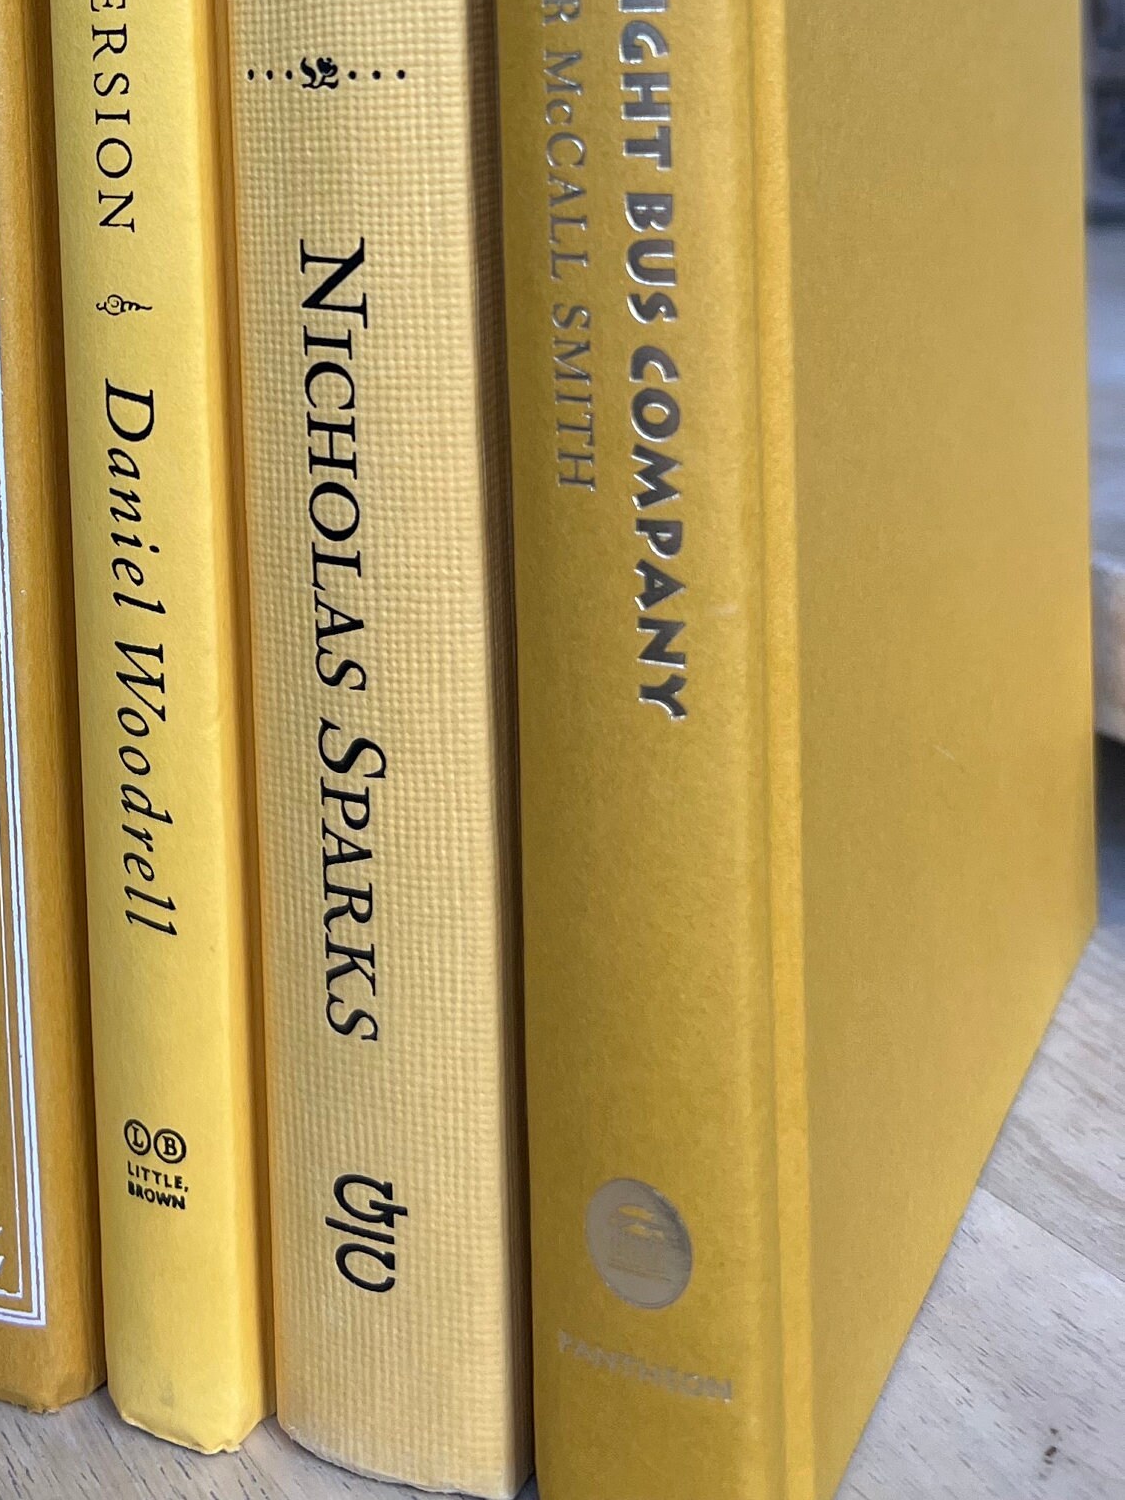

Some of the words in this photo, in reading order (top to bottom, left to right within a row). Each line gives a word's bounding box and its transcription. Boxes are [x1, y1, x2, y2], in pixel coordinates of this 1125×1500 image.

[623, 191, 679, 324] BUS
[104, 377, 167, 617] Daniel
[299, 236, 368, 692] NICHOLAS
[550, 302, 597, 493] SMITH
[629, 344, 688, 722] COMPANY
[114, 639, 177, 937] Woodrell
[318, 716, 387, 1042] SPARKS
[127, 1160, 189, 1192] LITTLE,
[127, 1180, 186, 1210] BROWN
